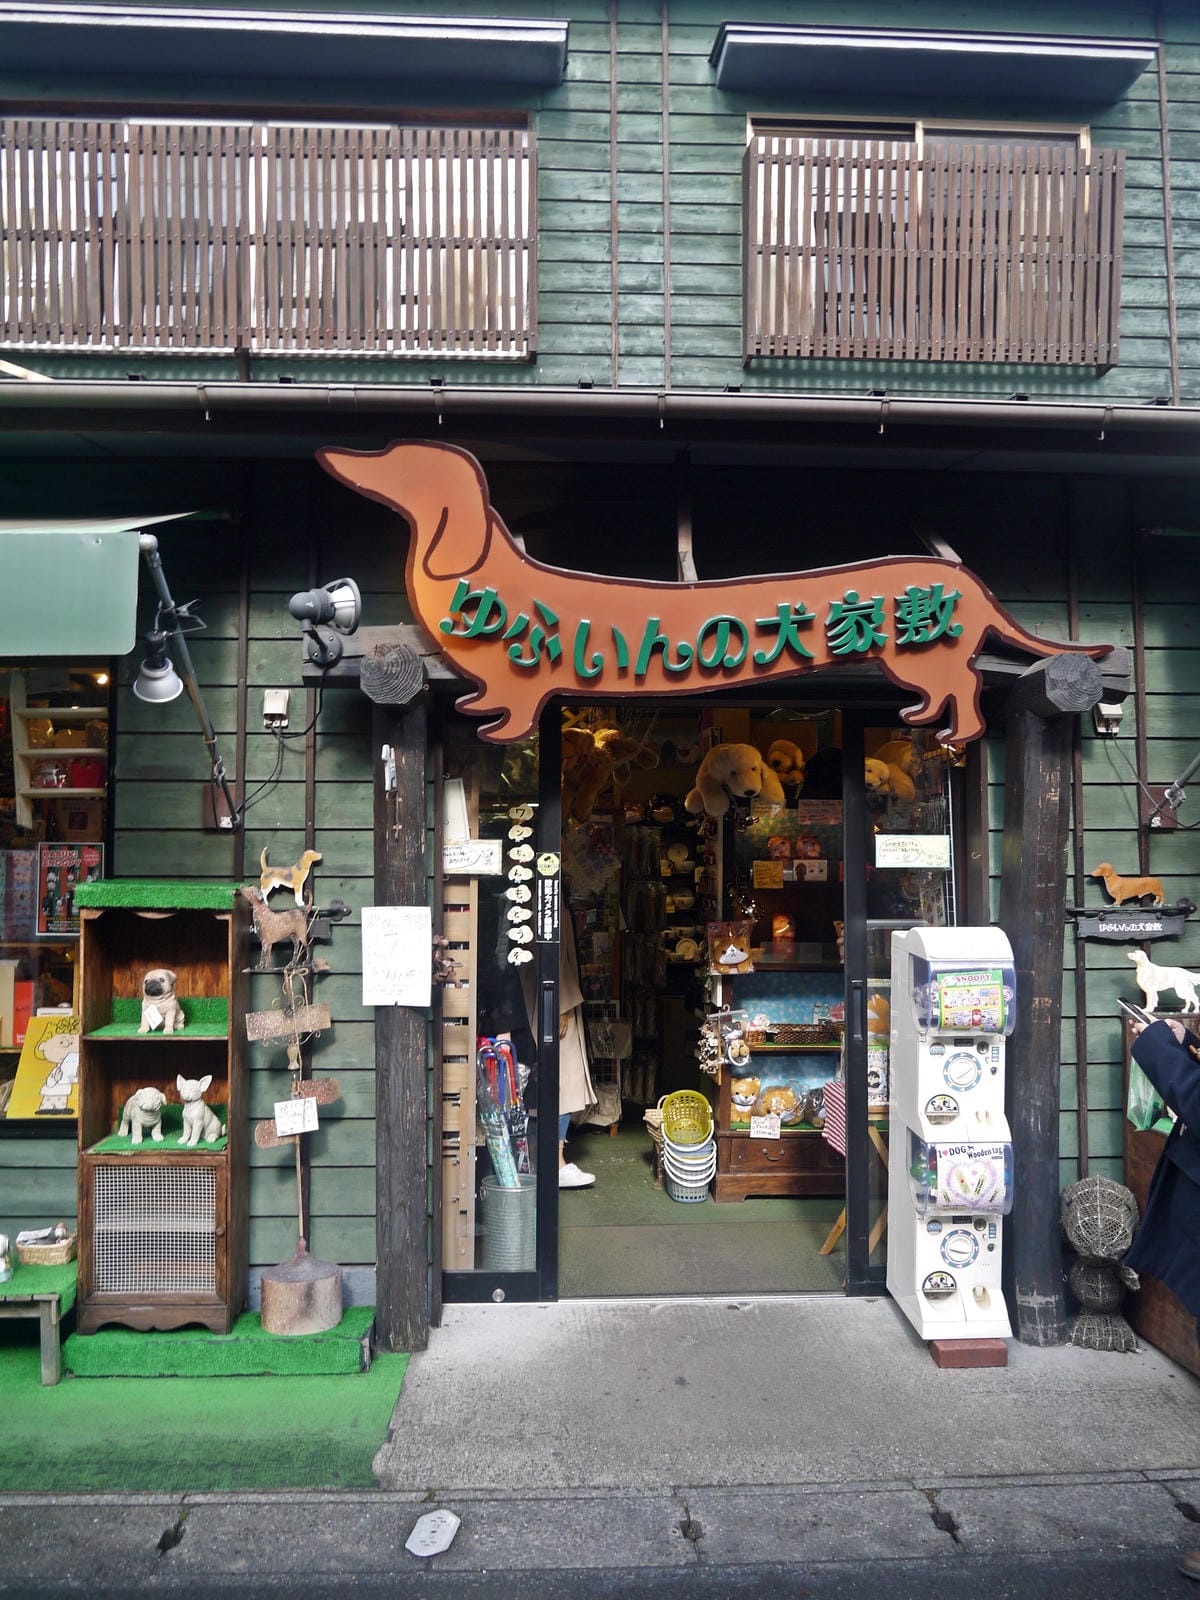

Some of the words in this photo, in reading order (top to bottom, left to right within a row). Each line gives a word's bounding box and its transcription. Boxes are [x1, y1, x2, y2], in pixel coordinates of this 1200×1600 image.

[439, 577, 963, 678] ゆふいんの犬家敷
[955, 974, 991, 982] SNOOPY
[949, 1146, 966, 1156] DOG
[967, 1149, 992, 1159] Wooden
